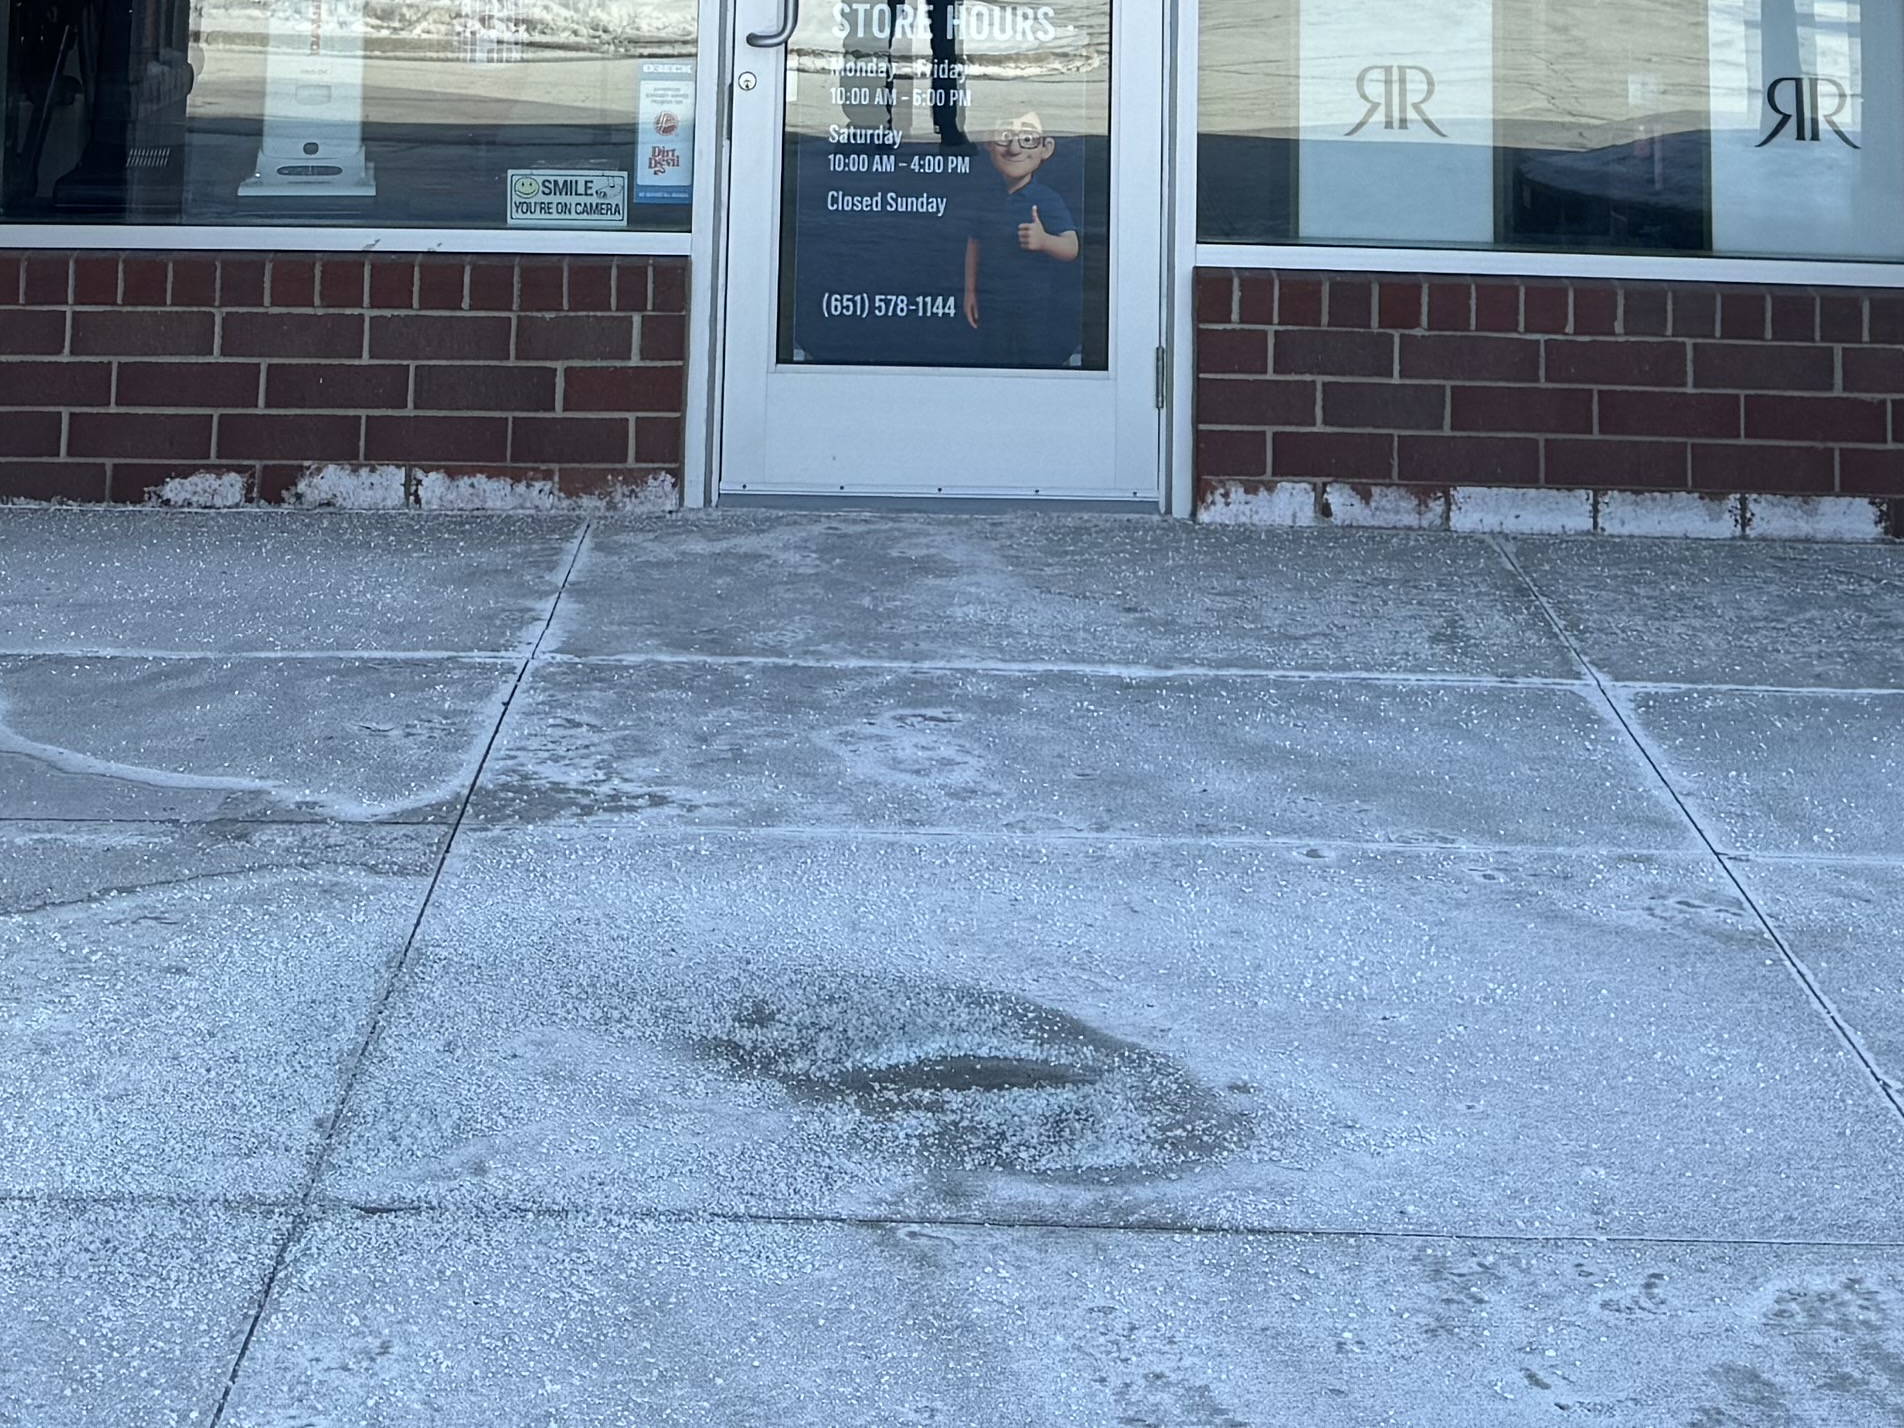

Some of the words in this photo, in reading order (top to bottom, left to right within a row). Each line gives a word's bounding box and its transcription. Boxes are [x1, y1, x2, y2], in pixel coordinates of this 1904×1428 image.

[831, 2, 934, 40] STORE
[947, 5, 1056, 42] HOURS
[642, 63, 692, 74] ORECK
[830, 58, 896, 82] Monday
[830, 87, 870, 106] 10:00
[874, 89, 896, 106] AM
[913, 89, 946, 106] 6:00
[949, 89, 972, 106] PM
[828, 124, 904, 150] Saturday
[651, 146, 676, 158] Dirt
[648, 156, 680, 174] Devil
[828, 154, 868, 172] 10:00
[872, 155, 896, 172] AM
[910, 155, 944, 174] 4:00
[947, 156, 970, 174] PM
[541, 180, 594, 198] SMILE
[514, 201, 554, 216] YOU'RE
[556, 202, 572, 216] ON
[574, 203, 622, 216] CAMERA
[827, 191, 882, 212] Closed
[886, 192, 948, 218] Sunday
[822, 293, 870, 318] (651)
[874, 294, 956, 318] 578-1144
